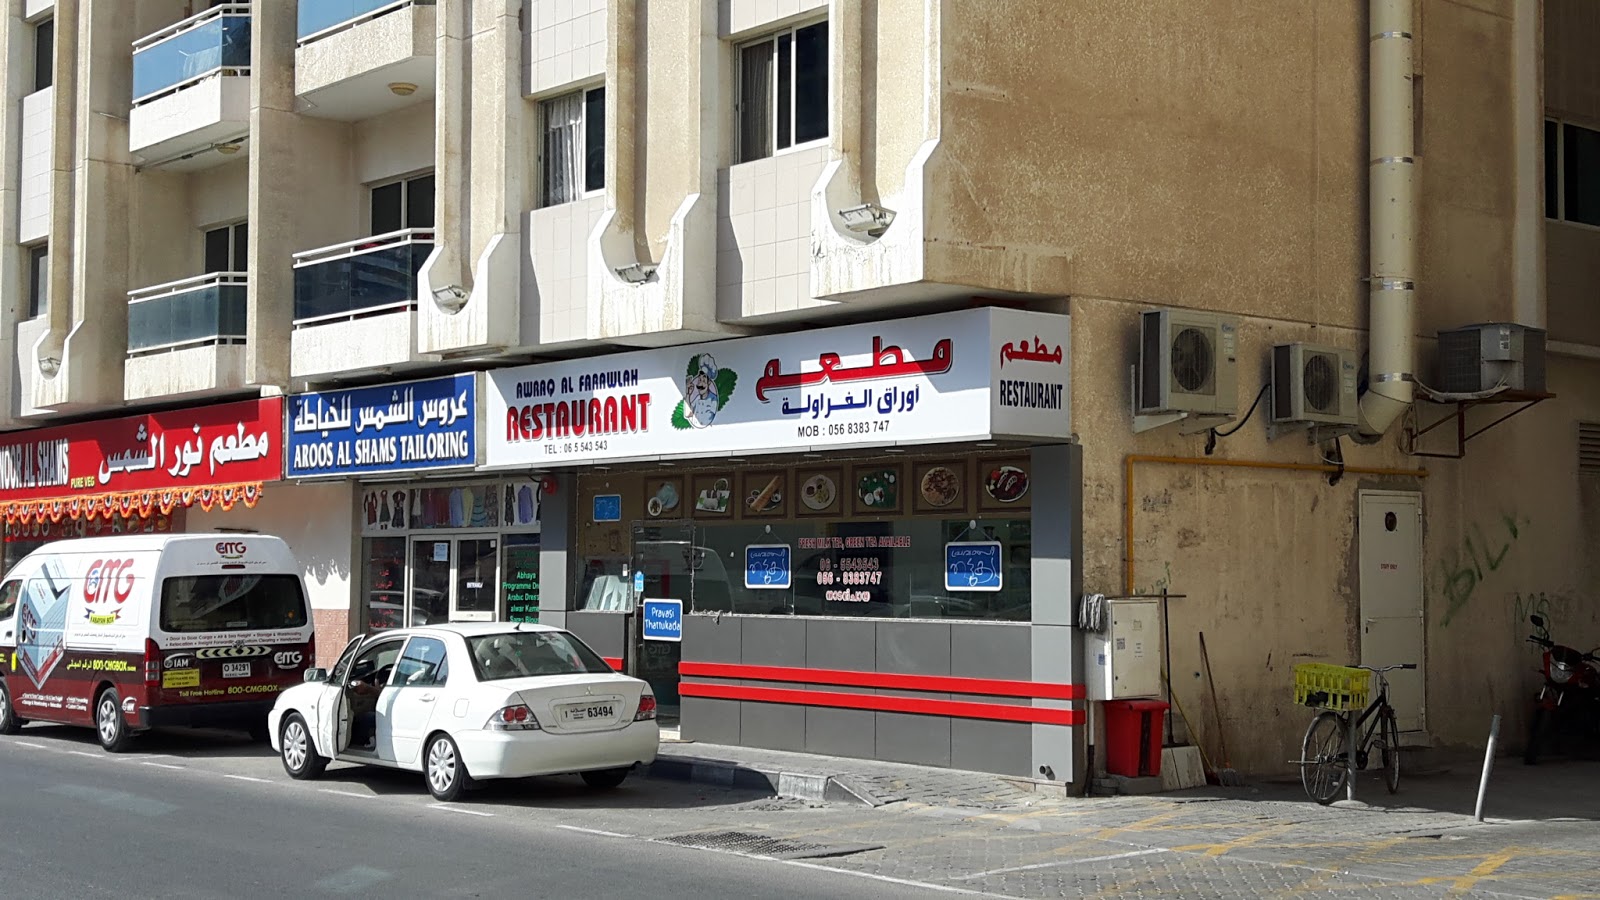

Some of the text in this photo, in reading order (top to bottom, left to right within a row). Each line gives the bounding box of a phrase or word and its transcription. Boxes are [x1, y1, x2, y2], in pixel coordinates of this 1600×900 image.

[999, 335, 1062, 370] مطعم
[516, 369, 639, 399] AWRAQ AL FARAWLAH
[755, 335, 954, 403] مطعم
[781, 384, 920, 419] أوراق الفراولة
[999, 380, 1063, 410] RESTAURANT
[293, 386, 468, 438] عروس الشمس للخياطة
[506, 393, 652, 443] RESTAURANT
[797, 425, 820, 438] MOB
[828, 423, 845, 435] 056
[847, 422, 871, 434] 8383
[873, 420, 890, 433] 747
[23, 442, 35, 487] AL
[37, 437, 69, 487] SHAMS
[98, 421, 269, 484] مطعم نور الشمس
[293, 430, 469, 468] AROOS AL SHAMS TAILORING
[544, 444, 558, 455] TEL
[563, 443, 573, 453] 06
[574, 442, 579, 452] 5
[580, 441, 593, 452] 543
[595, 440, 608, 451] 543
[70, 476, 95, 488] PURE VEG
[651, 606, 675, 618] Pravasi
[173, 658, 189, 668] IAM
[227, 684, 279, 694] 800-CMGBOX
[587, 706, 614, 718] 63494
